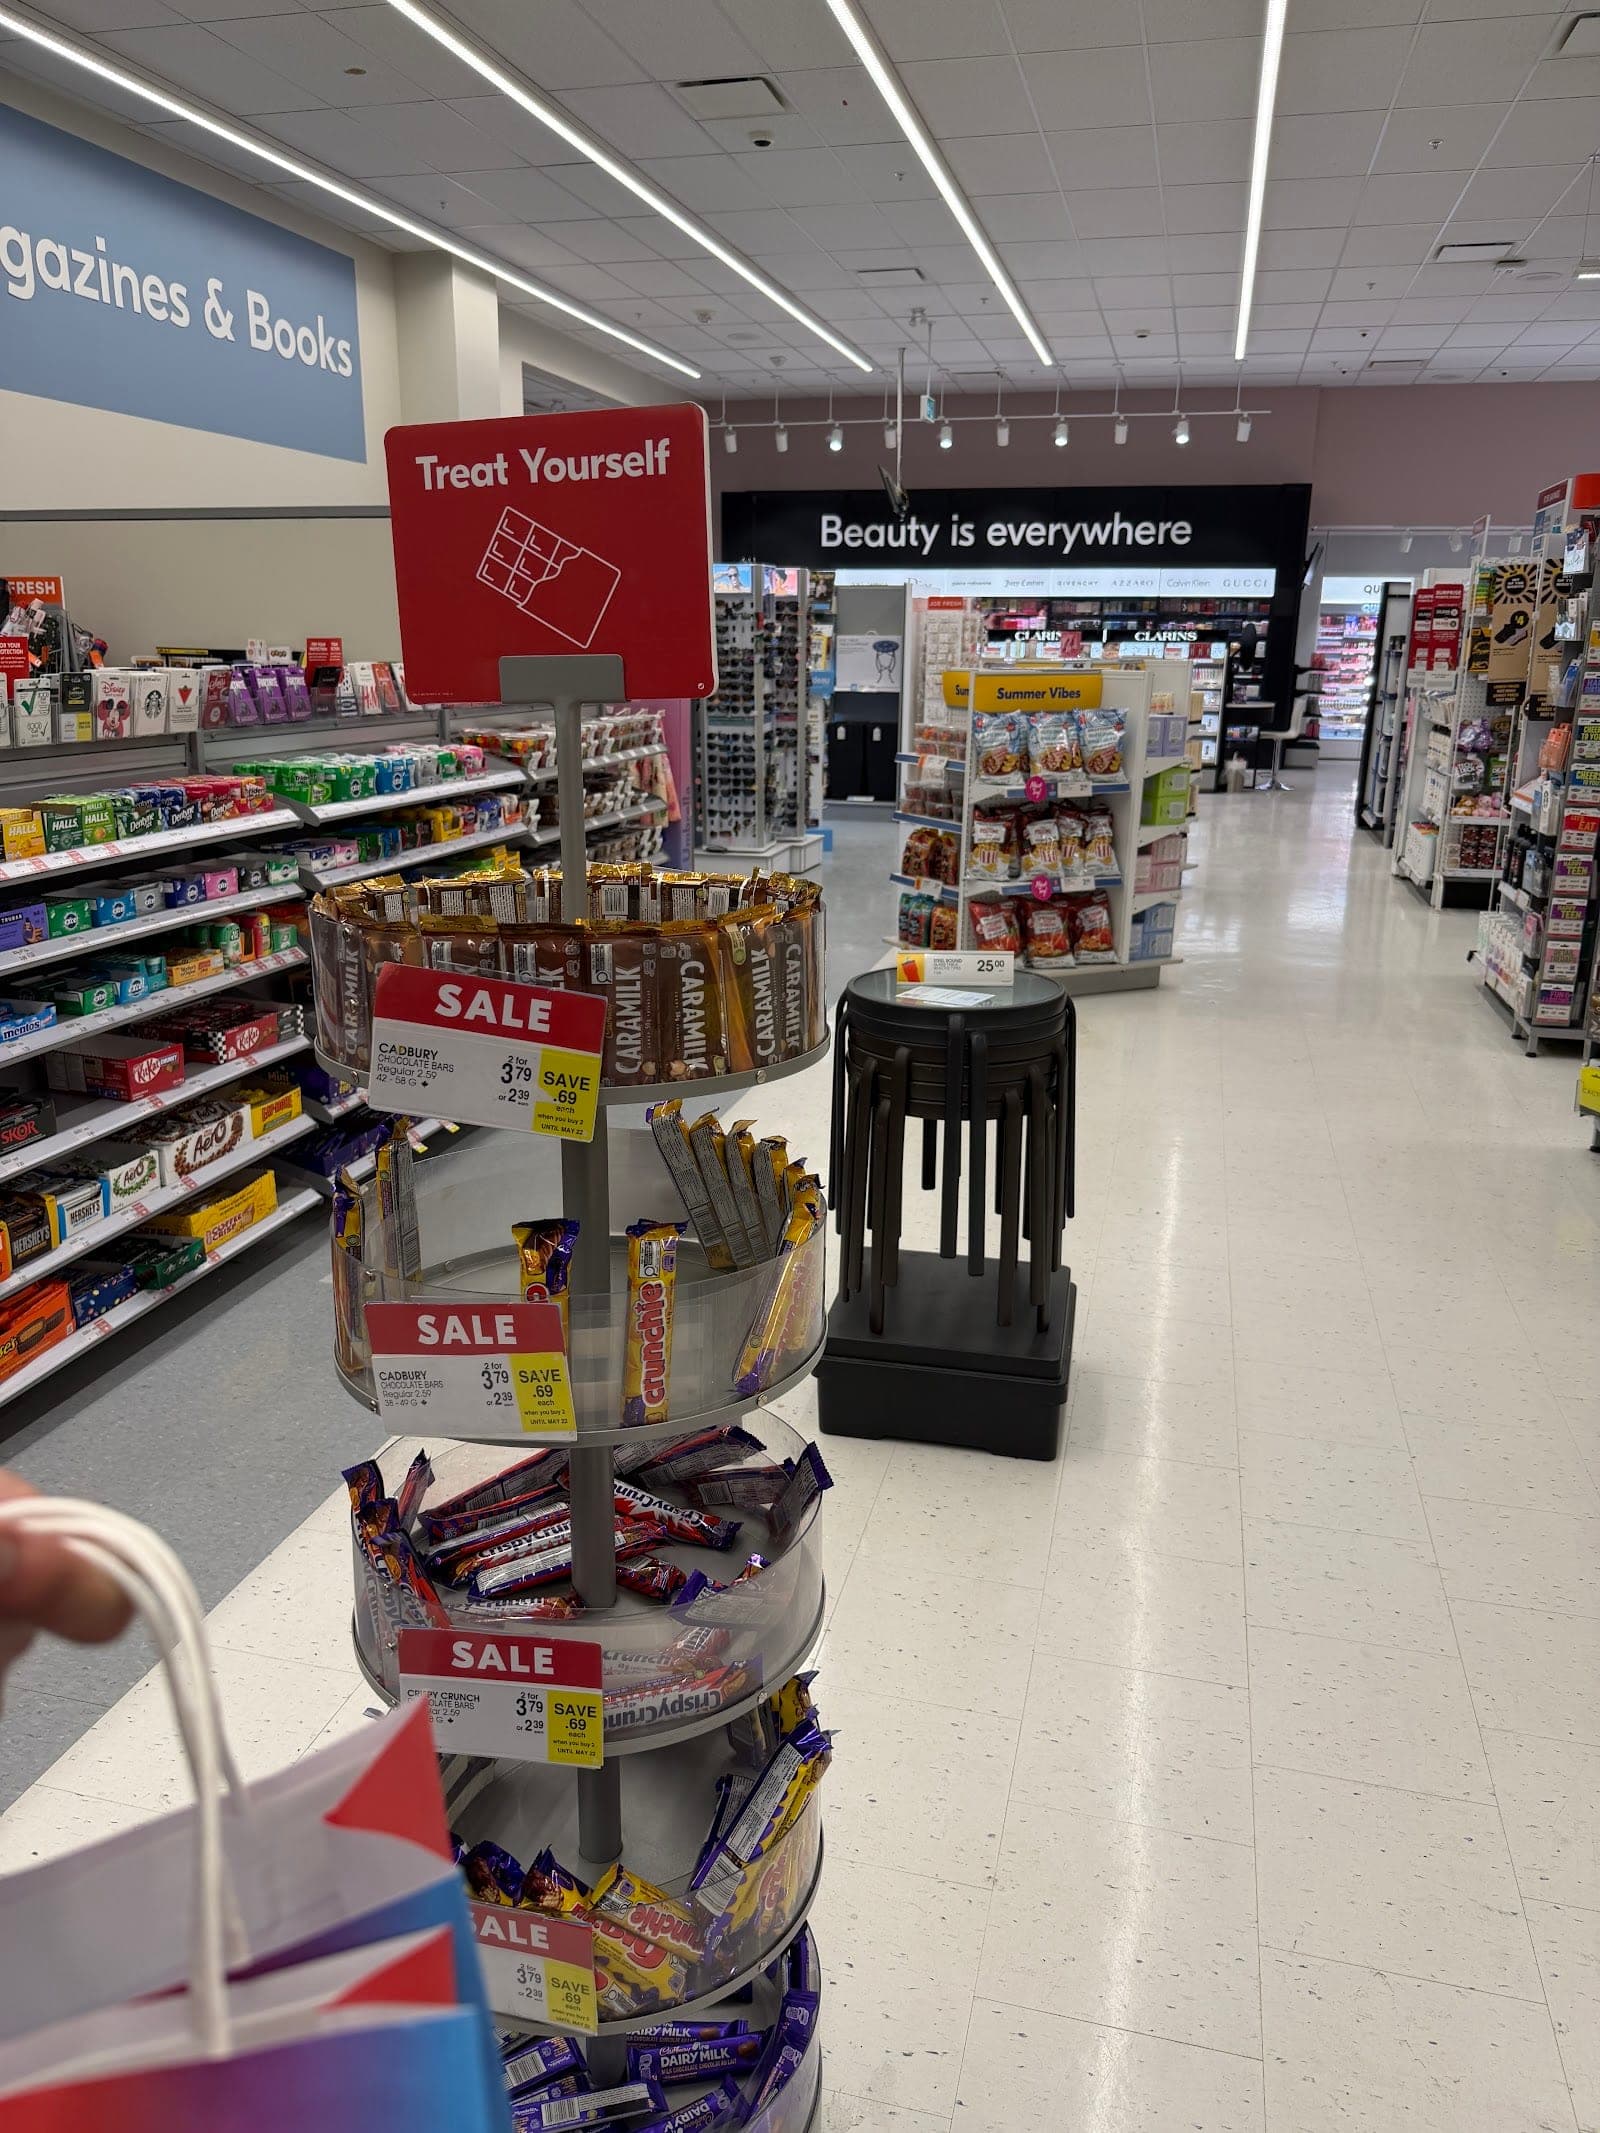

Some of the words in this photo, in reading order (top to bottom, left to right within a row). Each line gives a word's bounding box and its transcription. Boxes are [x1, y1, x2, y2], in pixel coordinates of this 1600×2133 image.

[0, 225, 190, 328] gazines
[204, 277, 235, 342] &
[246, 289, 353, 378] Books
[415, 452, 508, 491] Treat
[519, 437, 670, 484] Yourself
[820, 514, 940, 556] Beauty
[952, 513, 974, 547] is
[986, 512, 1193, 555] everywhere
[8, 581, 56, 595] FRESH
[1111, 579, 1154, 587] AZZARO
[1222, 578, 1269, 588] GUCCI
[1134, 631, 1198, 642] CLARINS
[996, 687, 1046, 700] Summer
[1049, 686, 1081, 700] Vibes
[84, 811, 110, 825] HALLS
[171, 803, 196, 825] Dentyne
[52, 816, 79, 832] HALLS
[130, 811, 155, 833] Dentyne
[1577, 821, 1595, 832] EAT
[8, 822, 37, 838] HALLS
[1568, 866, 1589, 876] TEEN
[1561, 910, 1581, 920] TEEN
[343, 951, 361, 1054] CARAMILK
[751, 947, 776, 1057] CARAMILK
[784, 944, 803, 1049] CARAMILK
[434, 983, 553, 1034] SALE
[680, 960, 709, 1071] CARAMILK
[614, 965, 642, 1075] CARAMILK
[3, 1021, 40, 1040] mentos
[378, 1042, 439, 1061] CADBURY
[377, 1053, 430, 1070] CHOCOLATE
[431, 1061, 455, 1073] BARS
[507, 1055, 514, 1064] 2
[515, 1056, 529, 1067] for
[376, 1063, 416, 1079] Regular
[416, 1068, 438, 1080] 2.59
[376, 1073, 388, 1083] 42
[395, 1076, 407, 1086] 58
[407, 1077, 417, 1087] G
[543, 1071, 591, 1092] SAVE
[498, 1093, 507, 1102] or
[552, 1089, 577, 1105] .69
[537, 1113, 553, 1121] when
[552, 1115, 566, 1125] you
[566, 1116, 580, 1126] buy
[1, 1121, 39, 1146] SKOR
[541, 1123, 560, 1132] UNTIL
[561, 1125, 575, 1135] MAY
[575, 1127, 584, 1136] 22
[70, 1200, 101, 1223] HERSHEY'S
[211, 1213, 243, 1235] COFFEE
[13, 1225, 50, 1256] HERSHEY'S
[416, 1314, 518, 1346] SALE
[634, 1281, 666, 1408] crunchie
[484, 1362, 490, 1370] 2
[491, 1361, 503, 1370] for
[378, 1369, 428, 1382] CADBURY
[518, 1368, 562, 1384] SAVE
[380, 1379, 424, 1390] CHOCOLATE
[424, 1379, 444, 1389] BARS
[532, 1384, 554, 1399] .69
[382, 1388, 415, 1400] Regular
[415, 1389, 432, 1399] 2.59
[400, 1399, 409, 1407] 49
[410, 1399, 418, 1407] G
[537, 1399, 555, 1407] each
[539, 1410, 550, 1418] you
[550, 1409, 561, 1417] buy
[451, 1640, 555, 1676] SALE
[440, 1691, 481, 1703] CRUNCH
[520, 1691, 526, 1699] 2
[527, 1692, 539, 1700] for
[442, 1708, 461, 1717] 2.59
[454, 1700, 476, 1710] BARS
[554, 1702, 598, 1719] SAVE
[565, 1718, 587, 1731] .69
[568, 1731, 587, 1739] each
[557, 1747, 573, 1755] UNTIL
[575, 1749, 588, 1757] MAY
[568, 1740, 580, 1748] you
[580, 1741, 591, 1749] buy
[526, 1964, 537, 1972] for
[551, 1976, 591, 1996] SAVE
[562, 1991, 582, 2006] .69
[662, 2027, 692, 2037] MILK
[660, 2052, 698, 2068] DAIRY
[700, 2047, 731, 2062] MILK
[672, 2064, 698, 2075] CHOCOLATE
[674, 2099, 711, 2128] DAIRY
